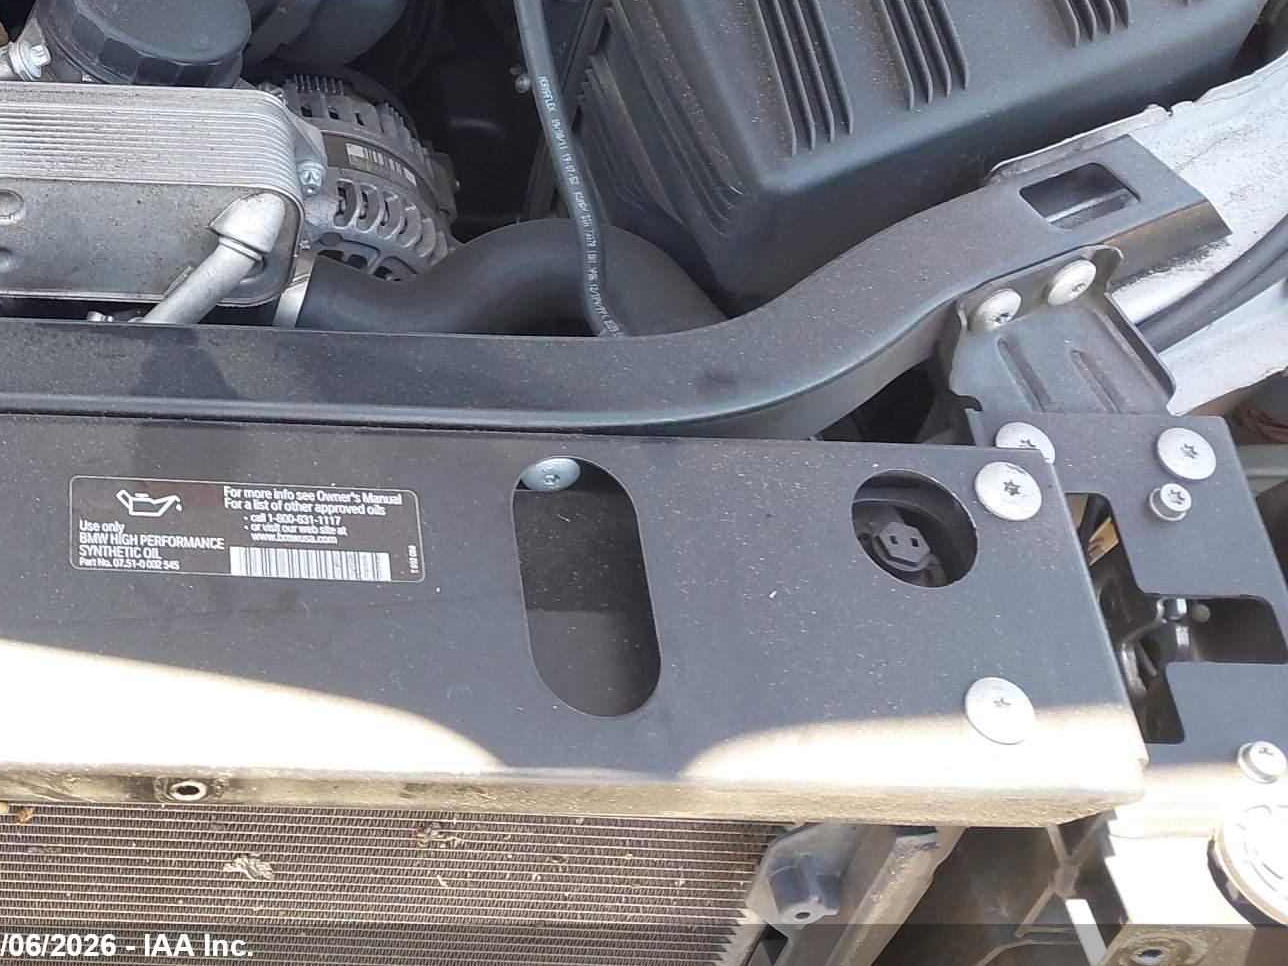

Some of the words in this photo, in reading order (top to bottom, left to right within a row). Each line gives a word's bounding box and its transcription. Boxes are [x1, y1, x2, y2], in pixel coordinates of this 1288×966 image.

[223, 486, 242, 498] For
[244, 488, 271, 499] more
[273, 488, 294, 500] info
[296, 490, 315, 501] see
[316, 490, 361, 503] Owner's
[363, 492, 402, 505] Manual
[224, 498, 243, 509] For
[244, 500, 252, 509] a
[253, 499, 269, 511] list
[270, 500, 283, 511] of
[284, 500, 313, 512] other
[314, 502, 365, 516] approved
[367, 504, 387, 516] oils
[250, 513, 266, 522] call
[267, 513, 341, 525] 1-800-831-1117
[79, 520, 100, 531] Use
[102, 521, 125, 534] only
[79, 533, 109, 545] BMW
[110, 534, 138, 546] HIGH
[140, 535, 225, 550] PERFORMANCE
[79, 545, 141, 559] SYNTHETIC
[143, 547, 162, 560] OIL
[79, 558, 96, 567] Part
[98, 559, 112, 568] No.
